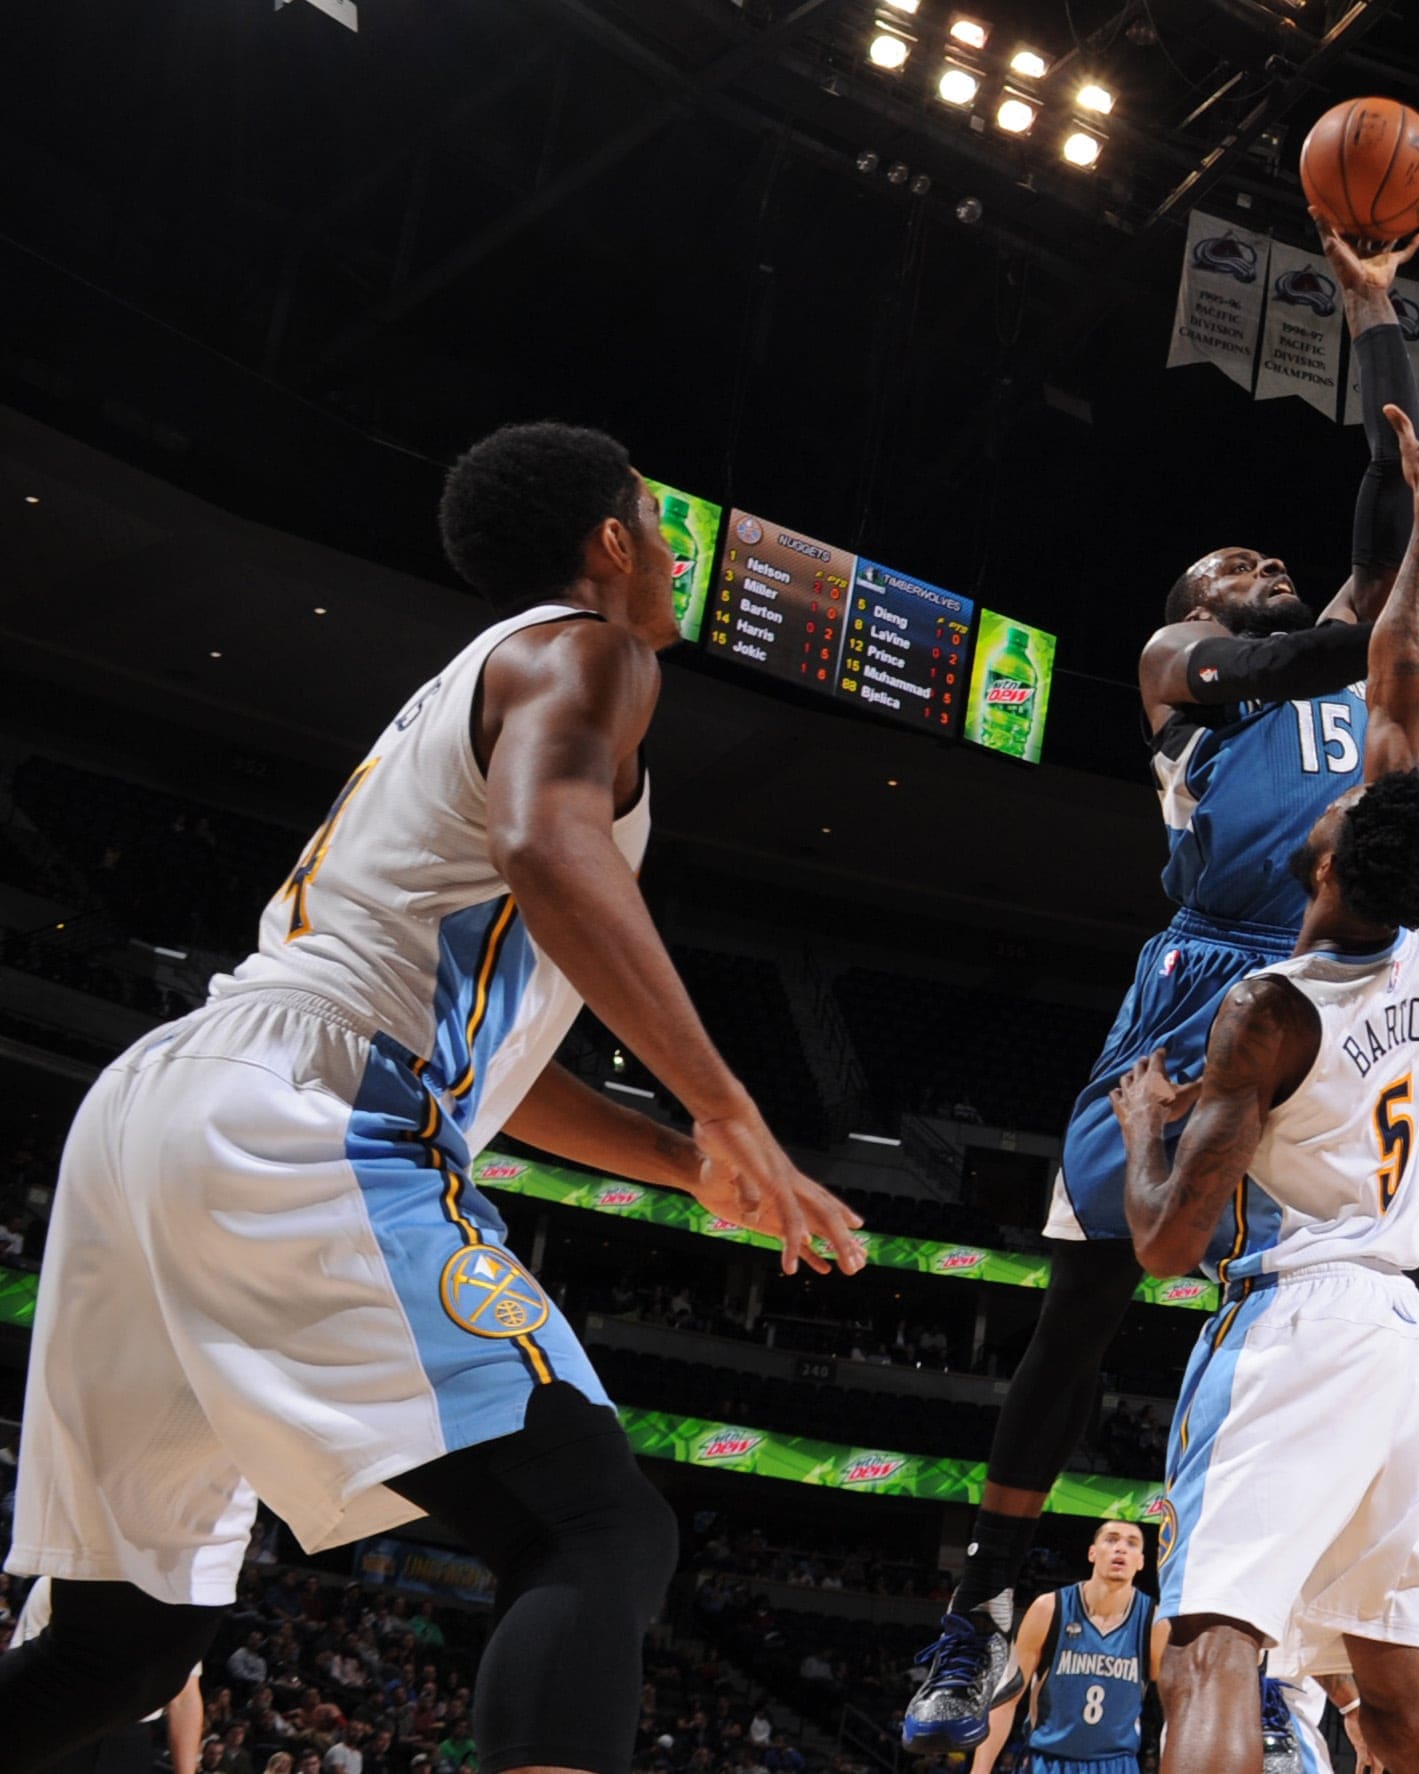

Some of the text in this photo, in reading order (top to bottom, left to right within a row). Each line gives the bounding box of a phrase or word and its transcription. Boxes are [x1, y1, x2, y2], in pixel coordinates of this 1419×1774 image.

[1179, 326, 1251, 356] CHAMPIONS
[1190, 315, 1244, 339] DIVISION
[1274, 349, 1326, 371] DIVISION
[1279, 336, 1326, 356] PACIFIC
[1264, 361, 1334, 387] CHAMPIONS
[778, 534, 832, 562] NUGGETS
[730, 550, 737, 561] 1
[747, 557, 791, 584] Nelson
[725, 570, 734, 582] 3
[743, 577, 779, 600] Miller
[883, 573, 962, 612] TIMBERWOLVES
[721, 590, 731, 602] 5
[739, 598, 784, 624] Barton
[858, 598, 866, 610] 5
[873, 605, 908, 630] Dieng
[715, 610, 731, 624] 14
[736, 619, 775, 642] Harris
[854, 618, 863, 630] 8
[870, 625, 911, 650] LaVine
[712, 631, 727, 645] 15
[732, 640, 767, 662] Jokic
[849, 638, 864, 652] 12
[867, 645, 906, 669] Prince
[846, 658, 860, 672] 15
[863, 664, 931, 699] Muhammad
[860, 685, 901, 710] Bjelica
[1291, 700, 1359, 774] 15
[1373, 1071, 1415, 1216] 5
[802, 1362, 829, 1376] 240
[1056, 1649, 1139, 1684] MINNESOTA
[1083, 1684, 1105, 1725] 8
